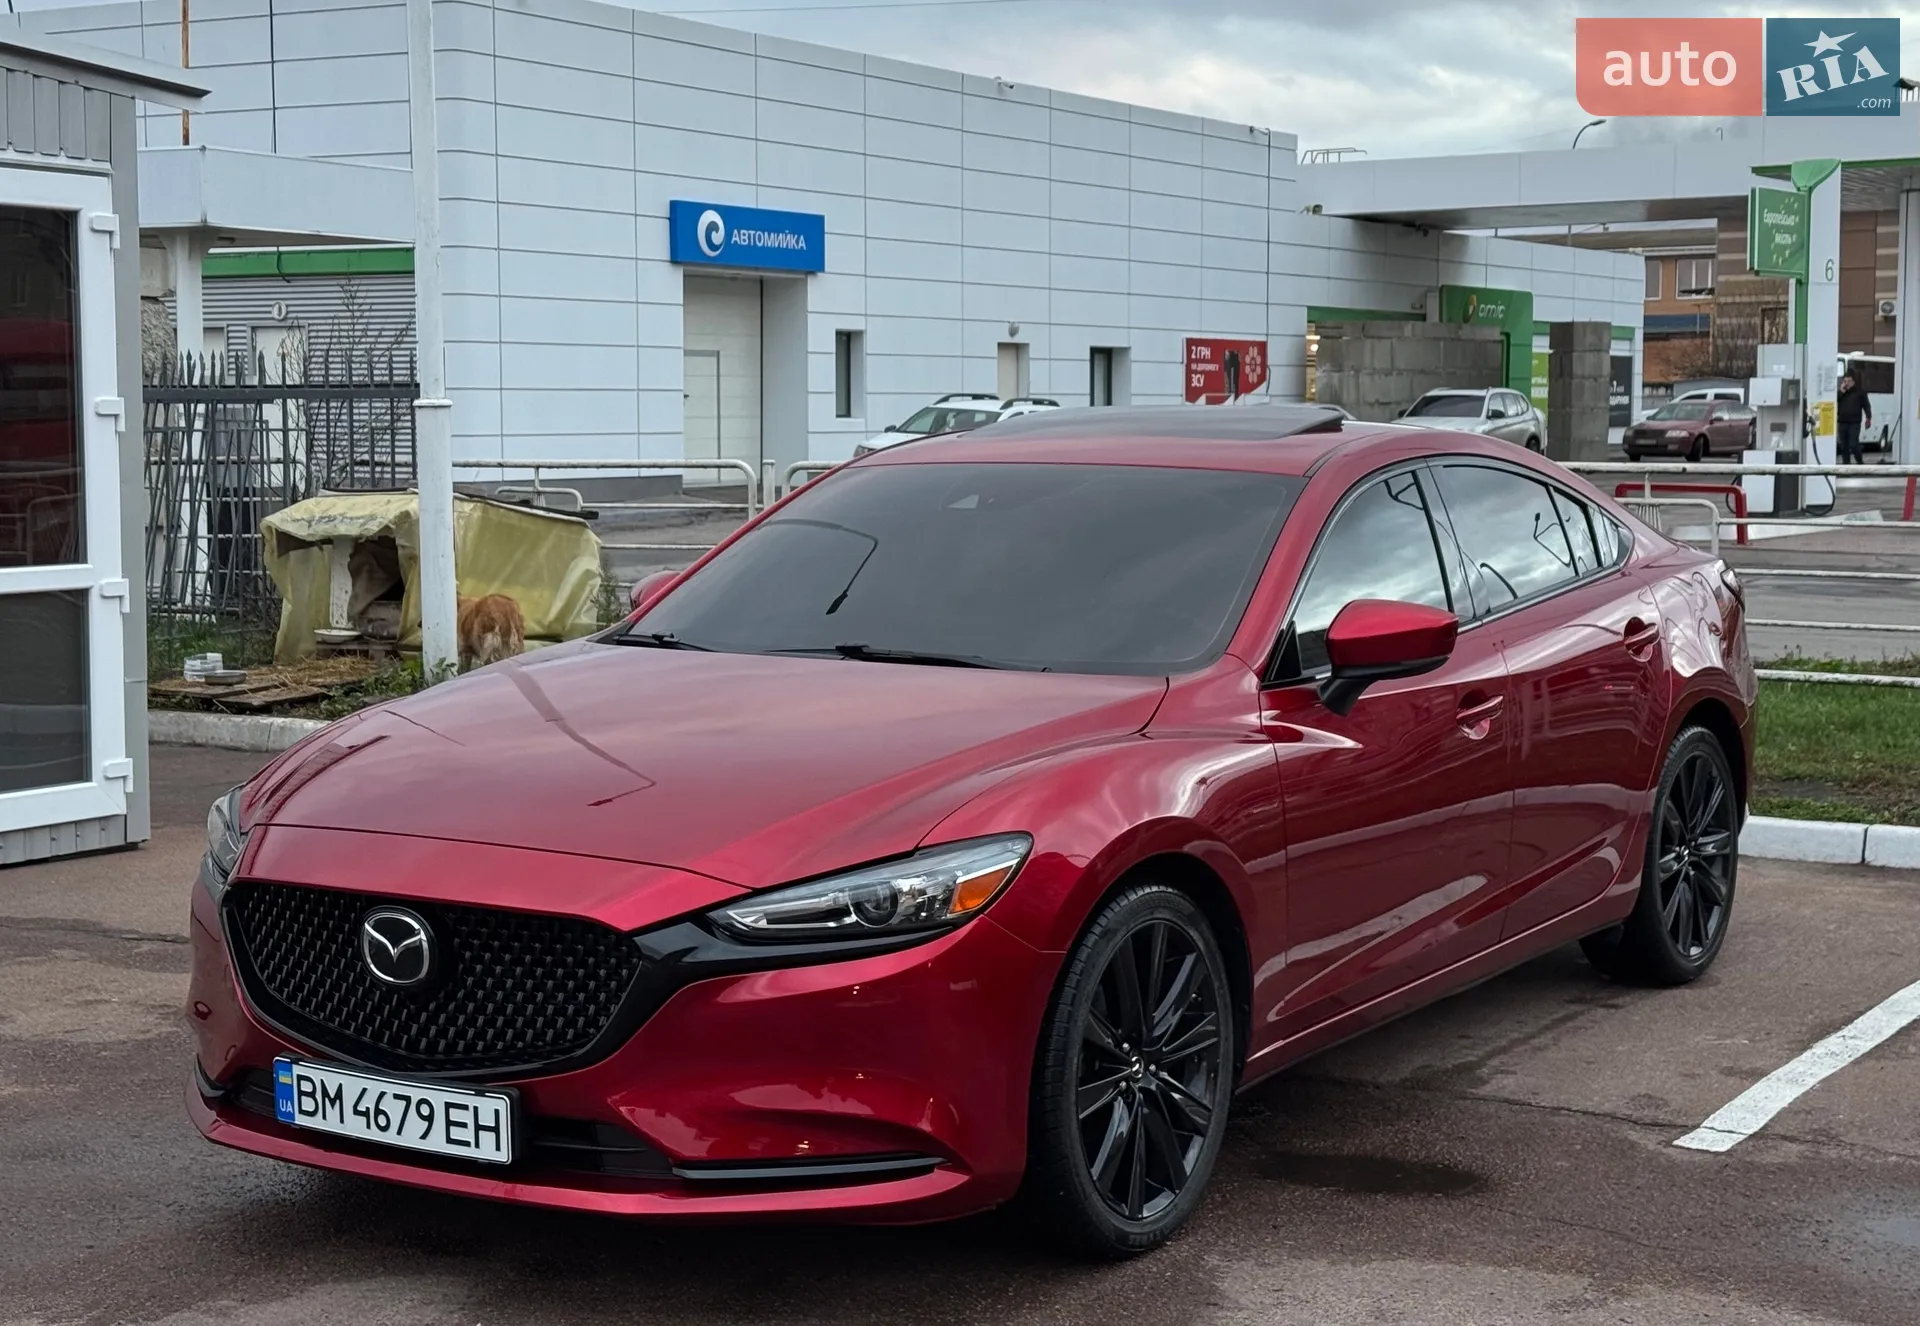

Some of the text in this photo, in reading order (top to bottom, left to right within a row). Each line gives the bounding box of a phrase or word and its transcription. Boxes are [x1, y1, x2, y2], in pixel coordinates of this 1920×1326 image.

[731, 229, 807, 250] АВТОМИЙКА
[1825, 259, 1835, 282] 6
[1191, 346, 1211, 360] 2 ГРН
[1191, 373, 1205, 387] ЗСУ
[279, 1099, 294, 1114] UA
[296, 1073, 502, 1153] BM 4679 EH
